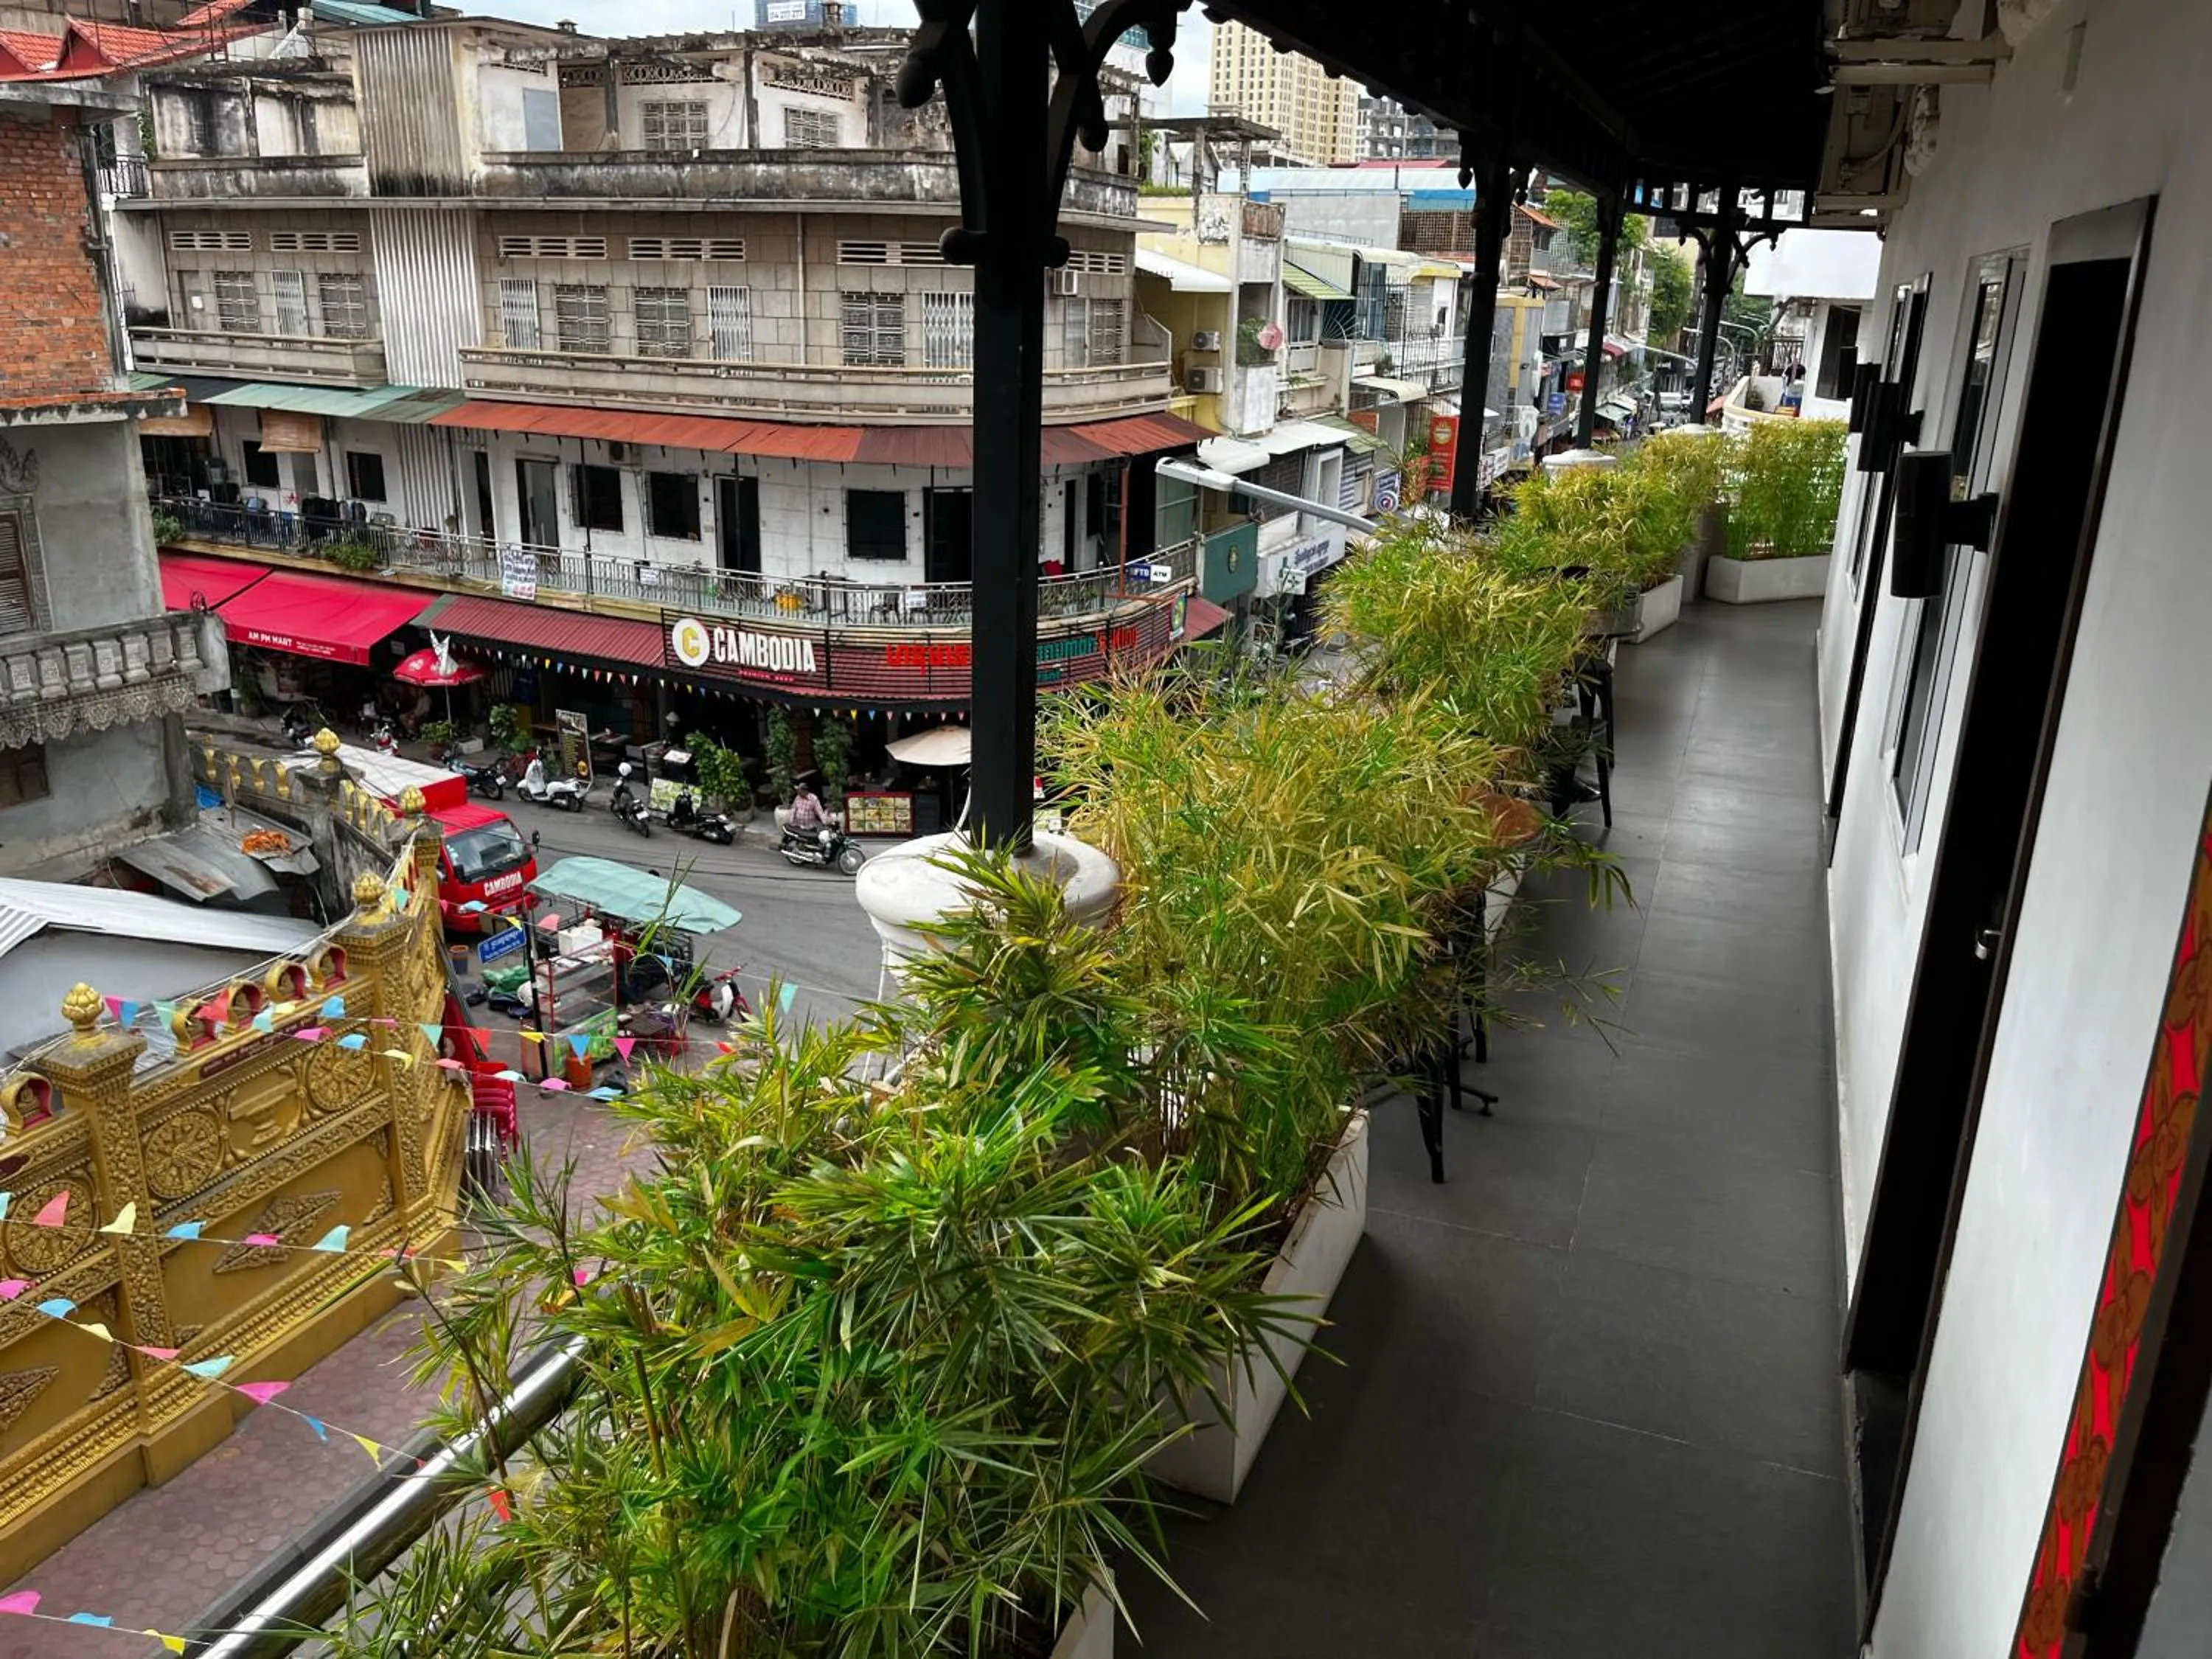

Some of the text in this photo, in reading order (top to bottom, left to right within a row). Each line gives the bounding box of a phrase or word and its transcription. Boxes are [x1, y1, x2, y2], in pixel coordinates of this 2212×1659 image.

[1152, 570, 1168, 578] ATM
[248, 630, 259, 641] AM
[260, 633, 271, 644] PM
[272, 635, 293, 647] MART
[713, 626, 816, 672] CAMBODIA
[483, 870, 522, 897] CAMBODIA
